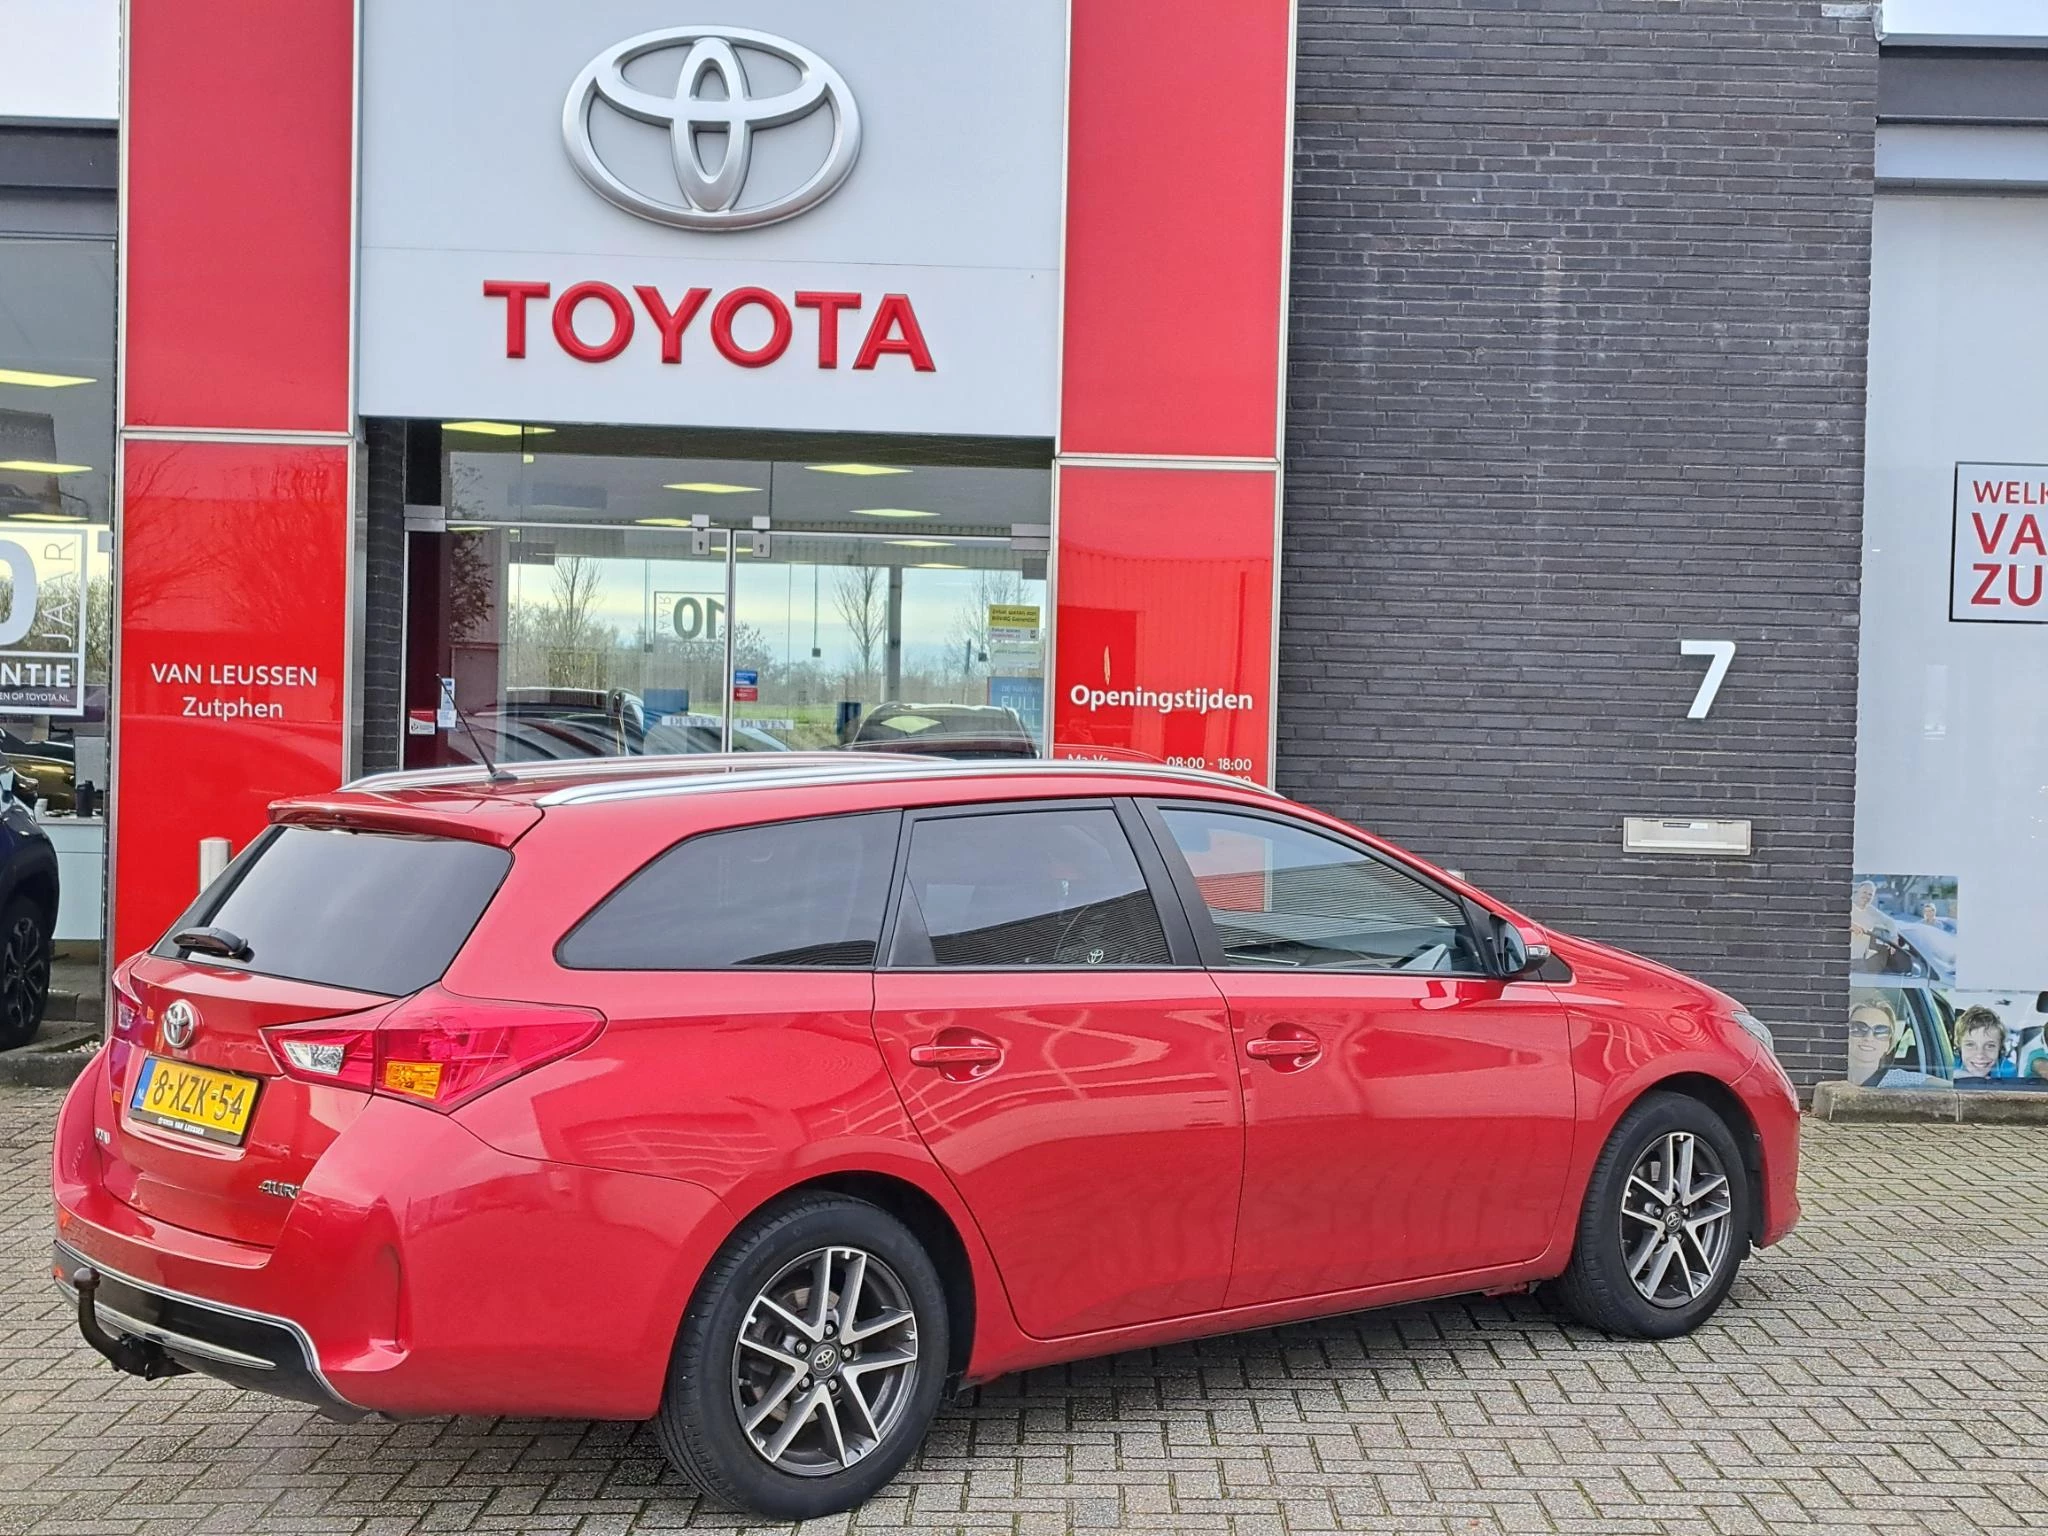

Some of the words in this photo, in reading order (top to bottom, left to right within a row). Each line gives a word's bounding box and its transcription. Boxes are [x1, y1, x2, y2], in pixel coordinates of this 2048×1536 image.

[483, 280, 936, 372] TOYOTA
[1972, 512, 2047, 556] VA
[1970, 563, 2043, 607] ZU
[151, 663, 202, 684] VAN
[210, 665, 317, 686] LEUSSEN
[1680, 640, 1736, 719] 7
[12, 692, 24, 700] OP
[26, 693, 71, 702] TOYOTA.NL
[183, 696, 283, 720] Zutphen
[1071, 685, 1253, 714] Openingstijden
[669, 716, 717, 727] DUWEN
[740, 719, 787, 730] DUWEN
[1166, 756, 1205, 769] 08:00
[1218, 758, 1252, 771] 18:00
[153, 1069, 246, 1124] 8-XZK-54
